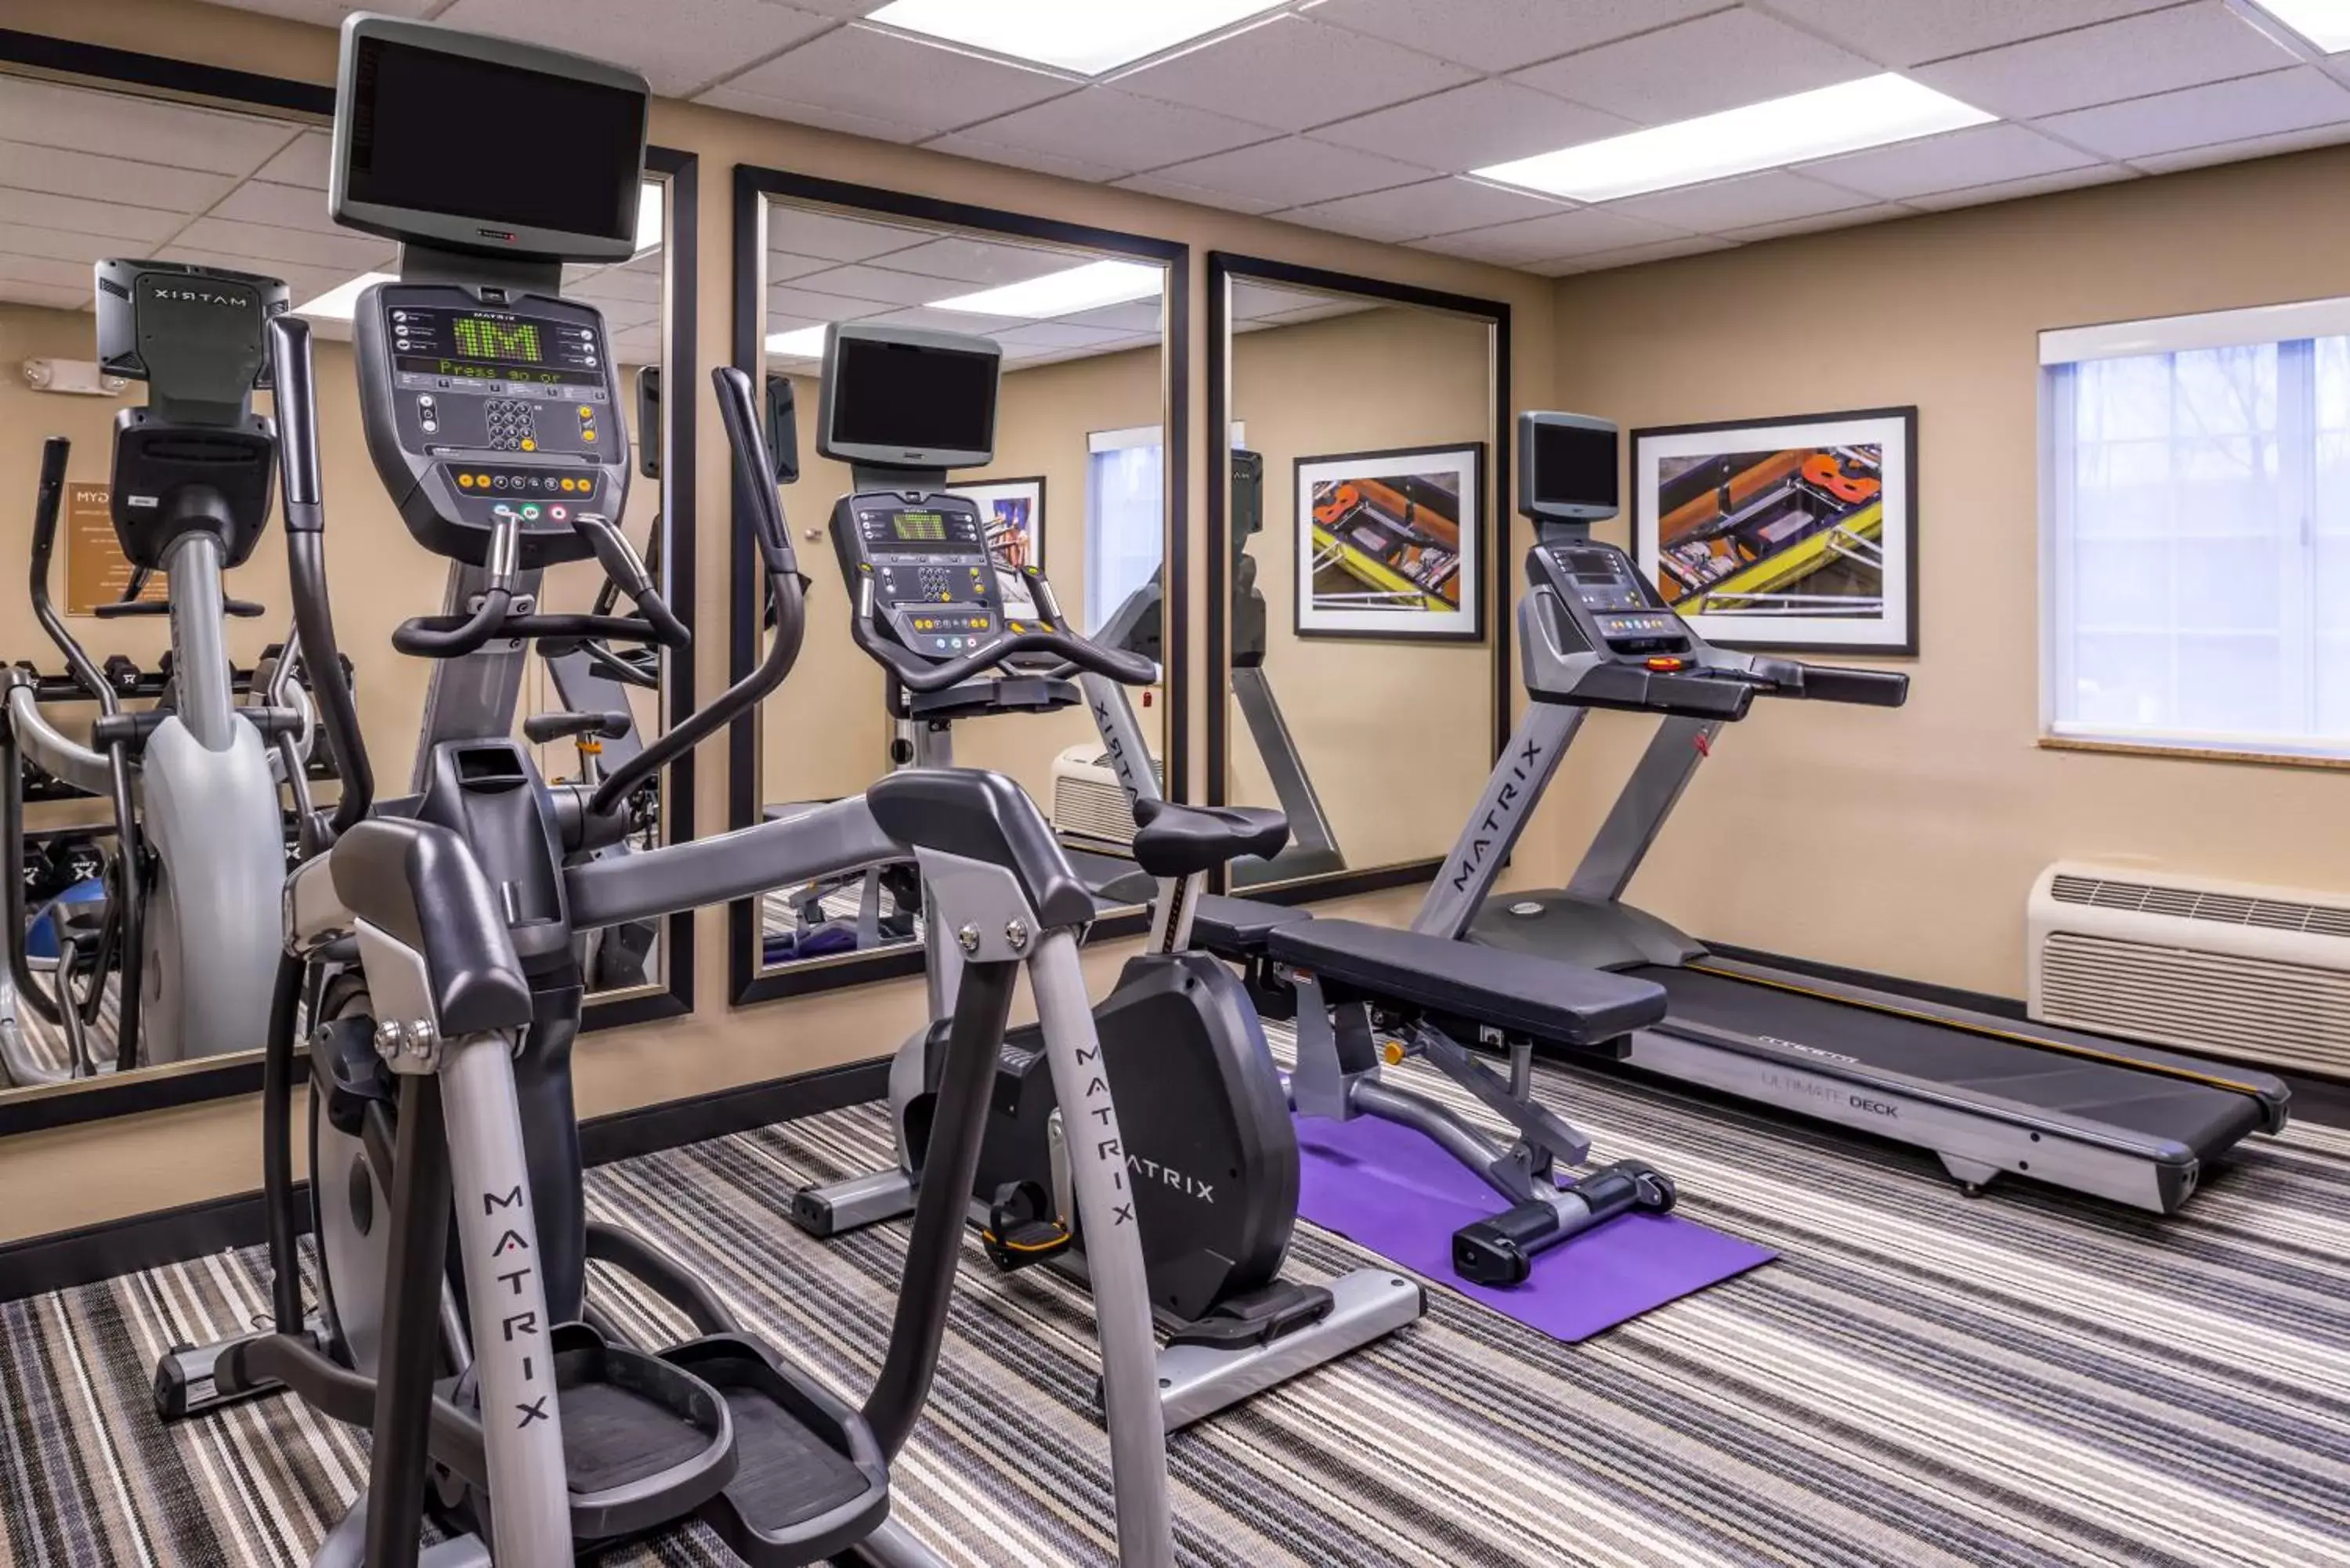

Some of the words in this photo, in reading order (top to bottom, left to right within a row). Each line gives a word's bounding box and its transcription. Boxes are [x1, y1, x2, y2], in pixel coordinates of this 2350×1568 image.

[440, 360, 497, 378] Press
[1453, 739, 1542, 892] MATRIX
[1076, 1044, 1133, 1226] MATRIX
[1762, 1071, 1844, 1104] ULTIMATE
[1849, 1095, 1899, 1118] DECK
[1126, 1153, 1214, 1204] ATRIX
[483, 1185, 550, 1429] MATRIX
